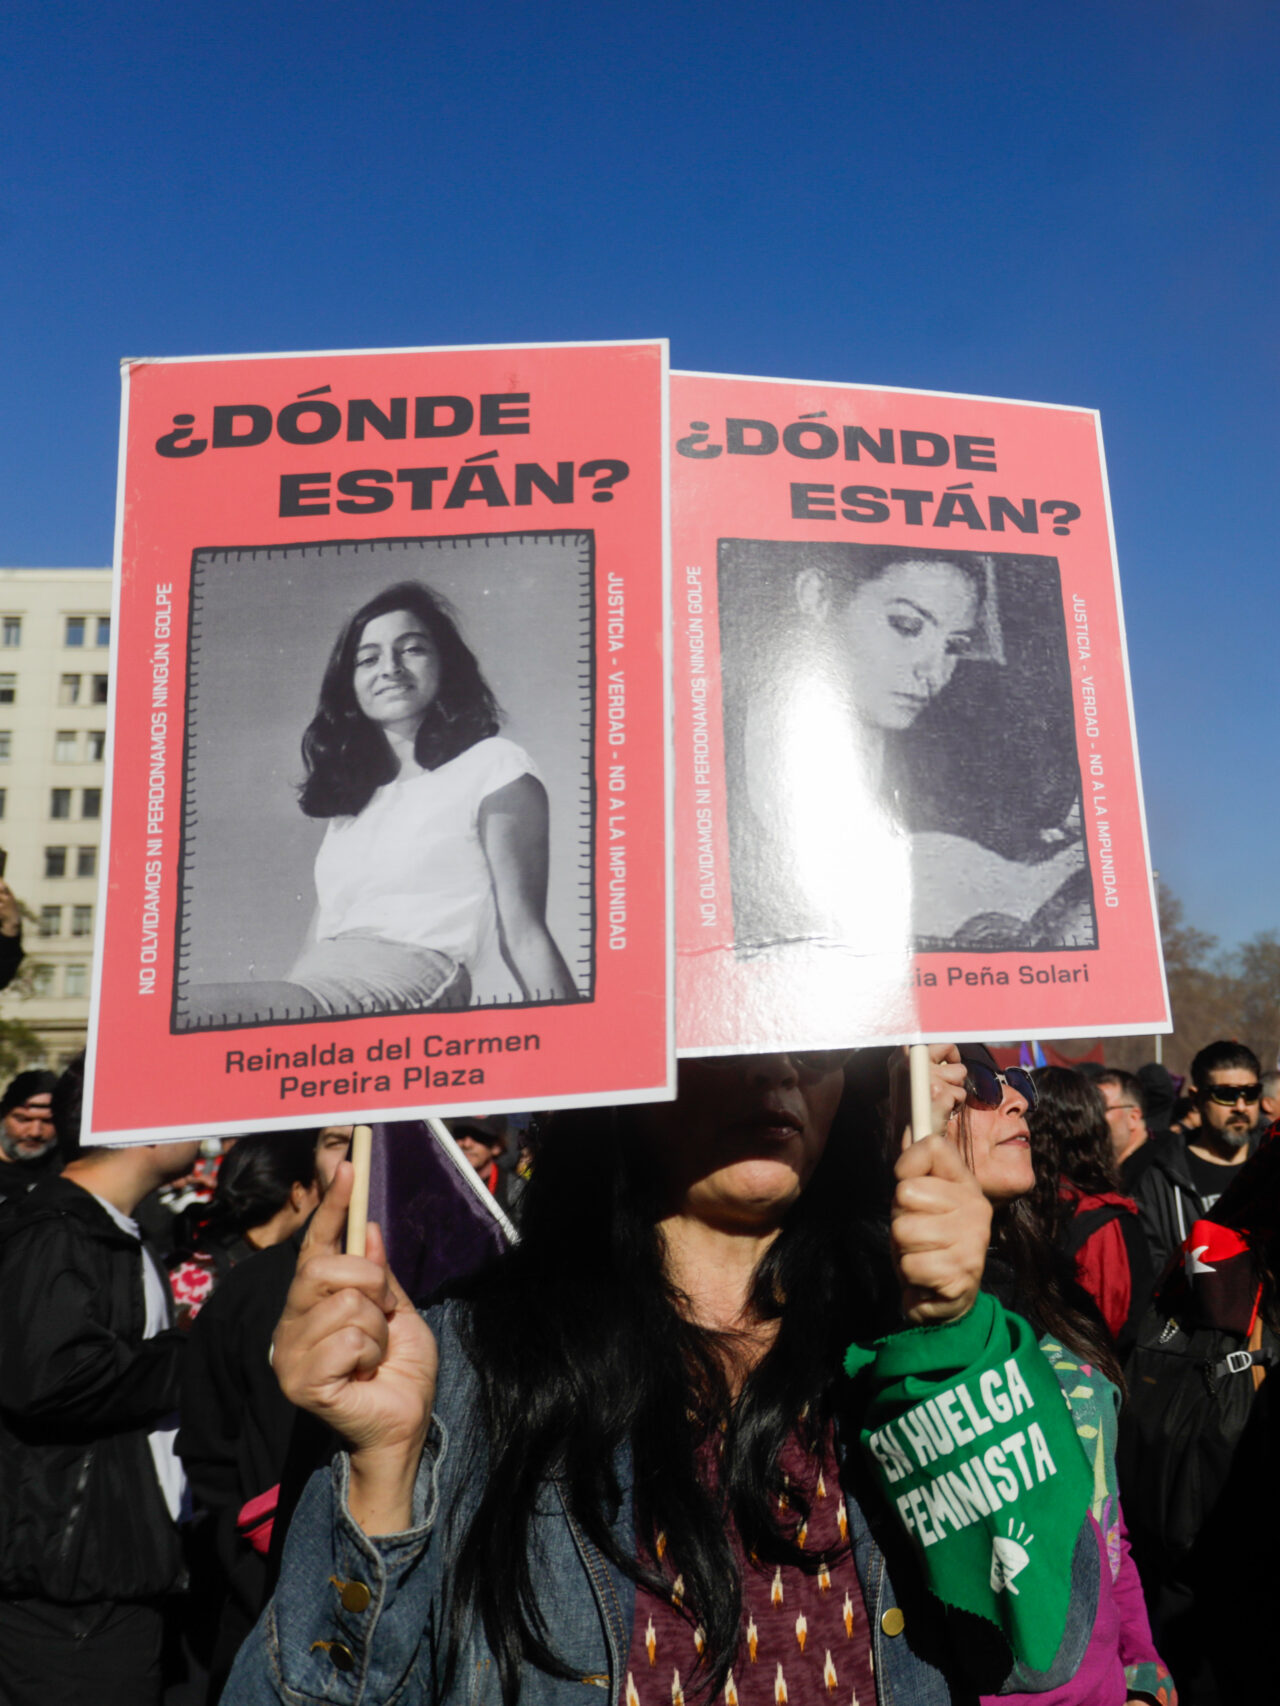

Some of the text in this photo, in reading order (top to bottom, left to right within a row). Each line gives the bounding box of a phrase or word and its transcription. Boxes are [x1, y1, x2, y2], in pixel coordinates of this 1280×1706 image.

[155, 384, 531, 459] ¿DÓNDE
[675, 410, 998, 473] ¿DÓNDE
[278, 449, 630, 518] ESTÁN?
[789, 481, 1082, 537] ESTÁN?
[608, 571, 624, 652] JUSTICIA
[1073, 593, 1091, 661] JUSTICIA
[609, 671, 625, 746] VERDAD
[1081, 675, 1099, 738] VERDAD
[686, 566, 716, 927] NO OLVIDAMOS NI PERDONAMOS NINGÚN GOLPE
[1089, 754, 1104, 776] NO
[139, 582, 172, 995] NO OLVIDAMOS NI PERDONAMOS NINGÚN GOLPE
[609, 765, 625, 792] NO
[609, 797, 625, 811] A
[1092, 780, 1105, 792] A
[1094, 795, 1107, 817] LA
[609, 815, 625, 841] LA
[1096, 820, 1119, 908] IMPUNIDAD
[610, 846, 626, 950] IMPUNIDAD
[947, 966, 1010, 987] Peña
[1018, 963, 1089, 985] Solari
[225, 1032, 541, 1074] Reinalda del Carmen
[279, 1065, 485, 1100] Pereira Plaza
[869, 1358, 1034, 1483] EN HUELGA
[896, 1421, 1057, 1547] FEMINISTA
